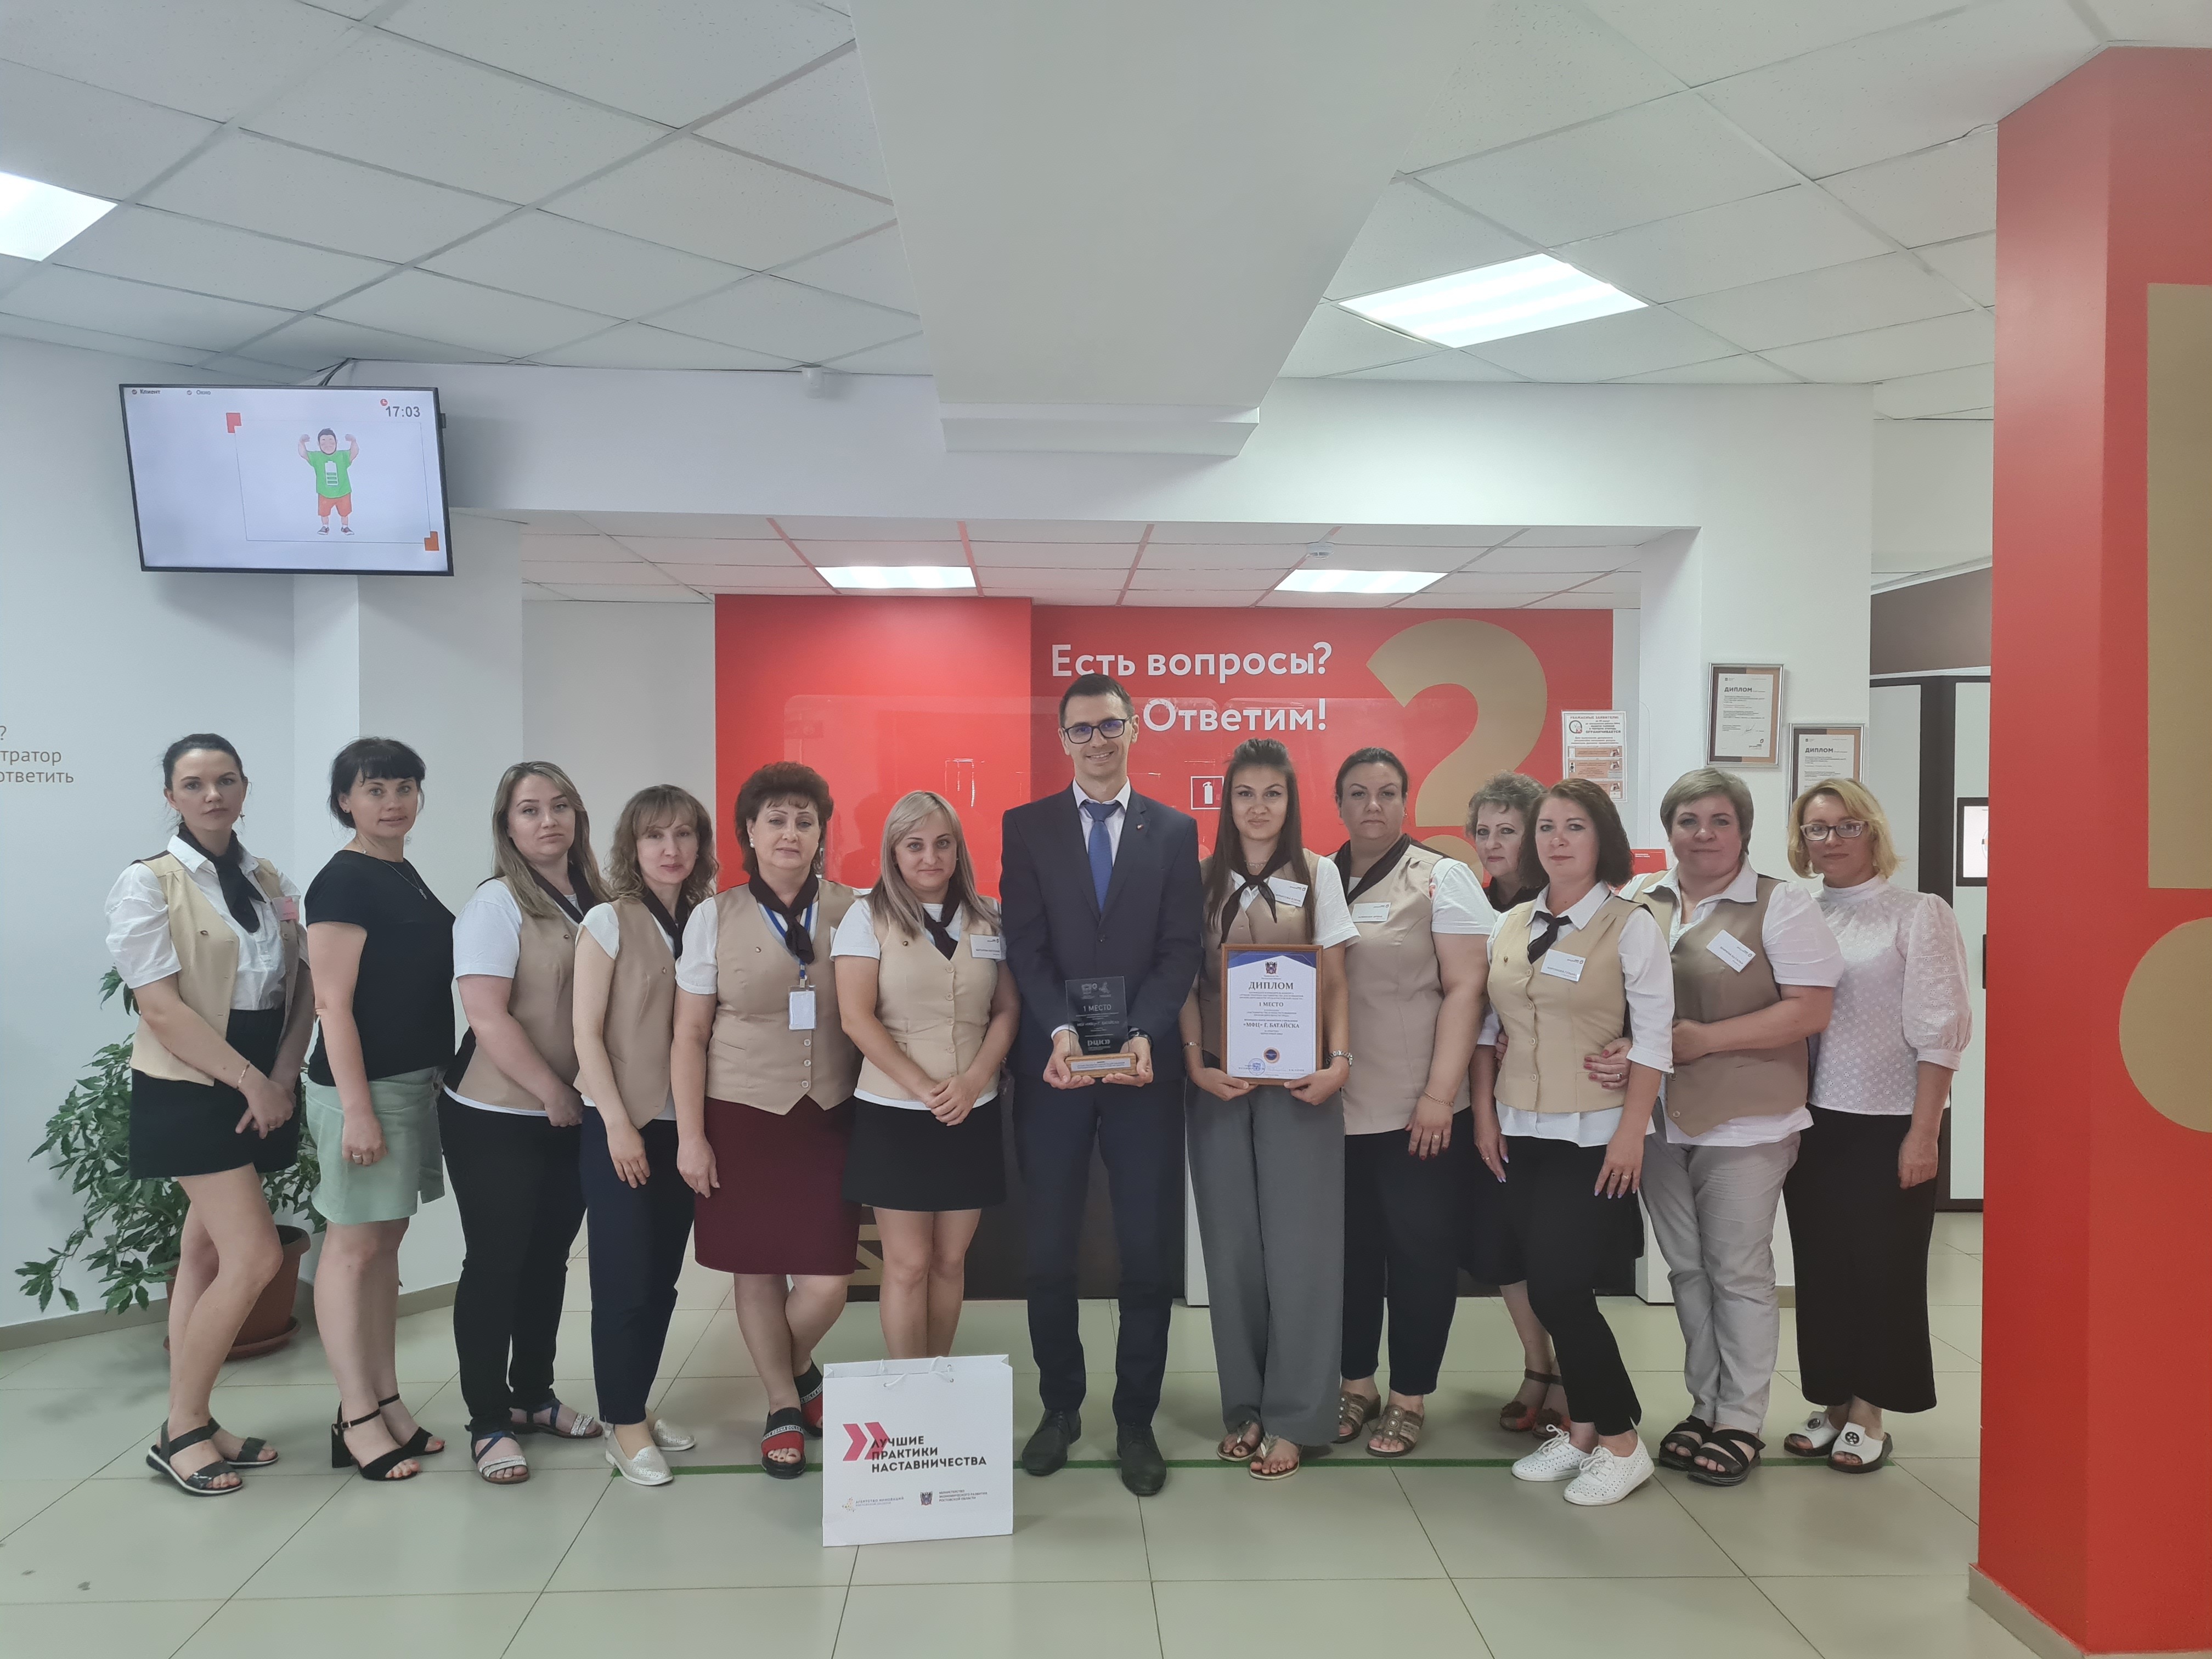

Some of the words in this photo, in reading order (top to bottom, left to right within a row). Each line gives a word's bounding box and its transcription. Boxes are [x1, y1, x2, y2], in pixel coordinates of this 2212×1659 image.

[385, 405, 421, 418] 17:03
[1051, 644, 1136, 677] Есть
[1147, 641, 1332, 684] вопросы?
[1143, 698, 1328, 732] Ответим!
[1248, 981, 1294, 991] ДИПЛОМ
[1088, 1004, 1111, 1012] МЕСТО
[871, 1435, 924, 1449] ЛУЧШИЕ
[871, 1446, 938, 1462] ПРАКТИКИ
[871, 1455, 987, 1473] НАСТАВНИЧЕСТВА
